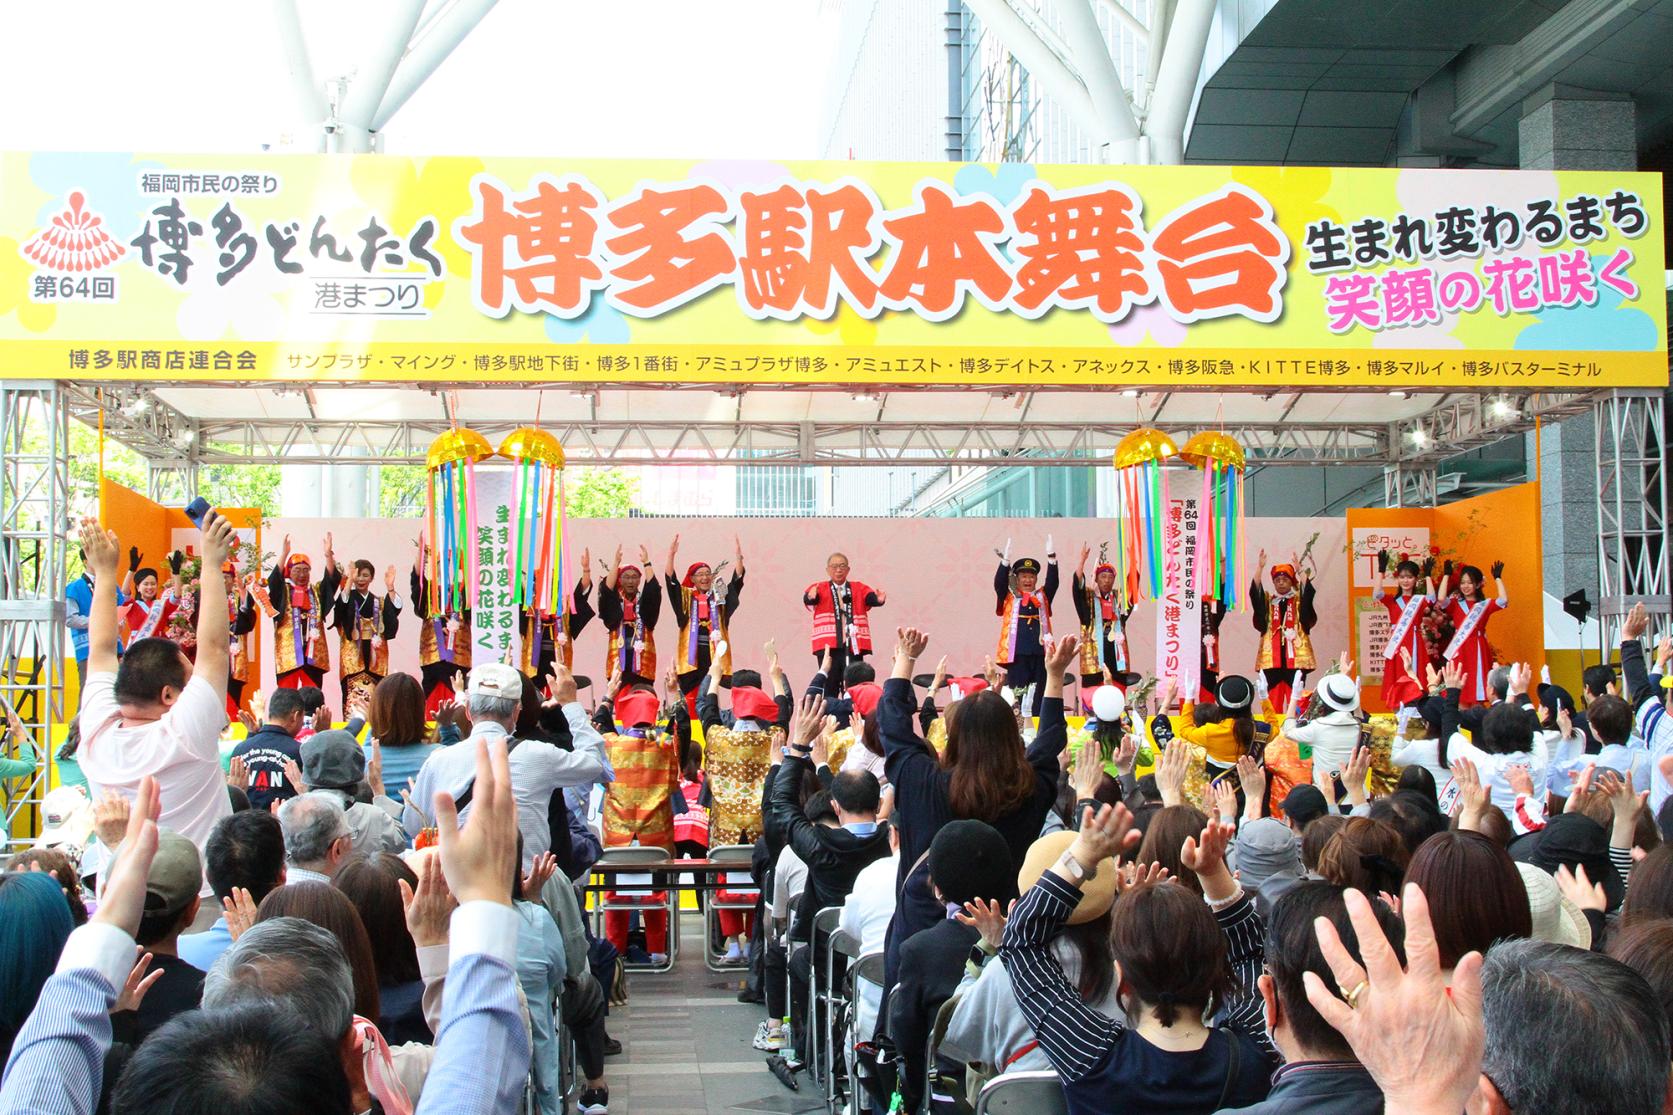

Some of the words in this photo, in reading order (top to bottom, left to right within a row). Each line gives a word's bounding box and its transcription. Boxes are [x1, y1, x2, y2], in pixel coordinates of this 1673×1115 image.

[141, 173, 278, 194] 福岡市民の祭り
[131, 197, 441, 286] 博多どんたく
[460, 181, 1281, 314] 博多駅本舞台
[1306, 191, 1645, 270] 生まれ変わるまち
[34, 275, 115, 299] 第64回
[314, 282, 419, 309] 港まつり
[1326, 249, 1638, 330] 笑顔の花咲く
[69, 349, 257, 370] 博多駅商店連合会
[477, 526, 494, 649] 笑顔の花咲く
